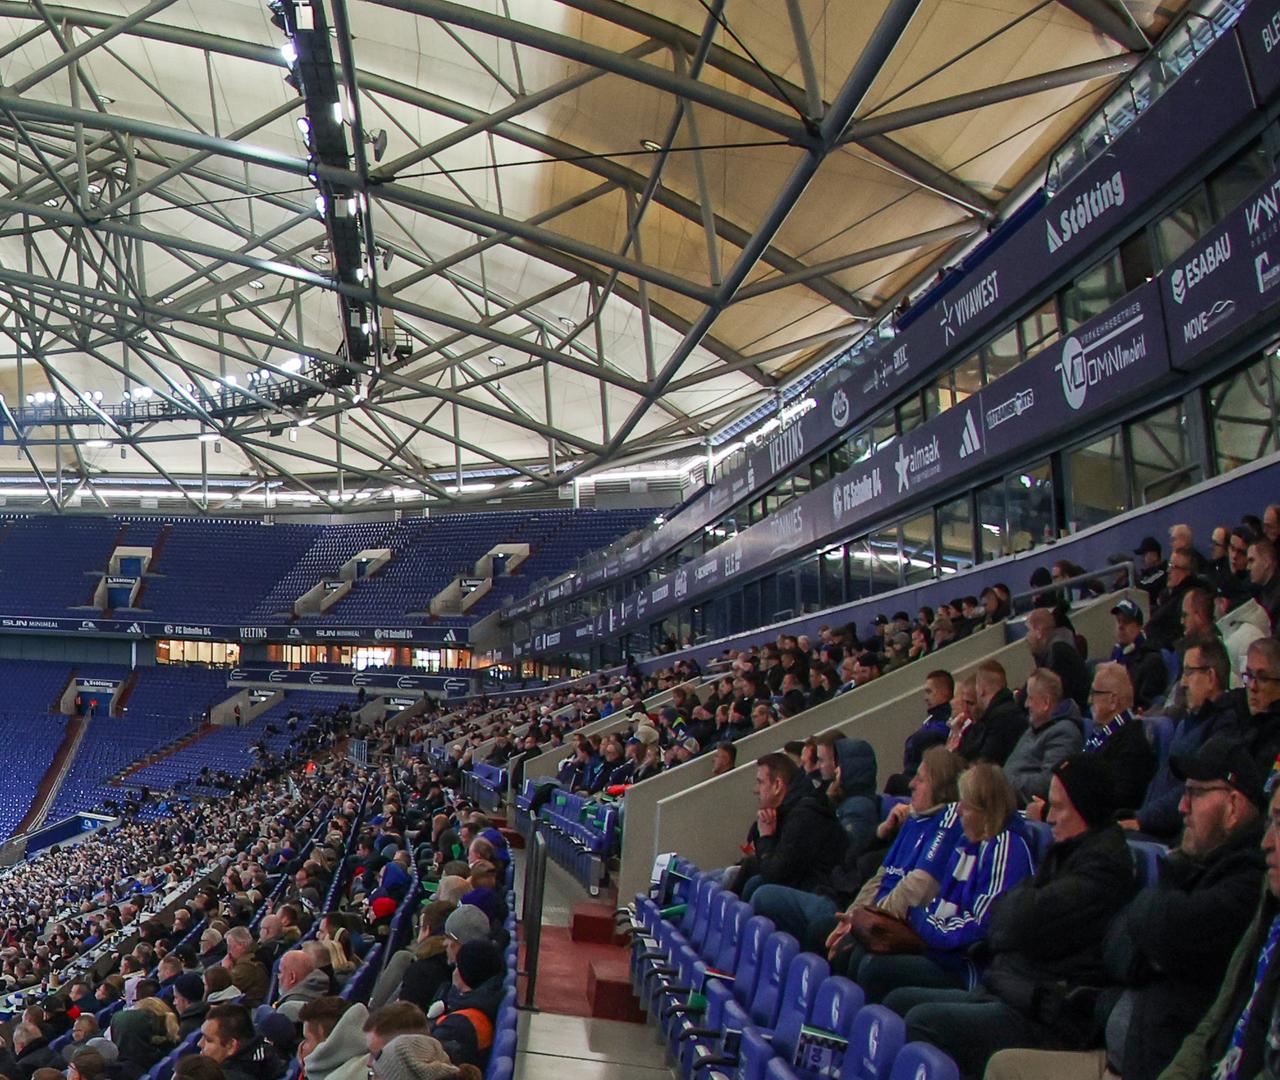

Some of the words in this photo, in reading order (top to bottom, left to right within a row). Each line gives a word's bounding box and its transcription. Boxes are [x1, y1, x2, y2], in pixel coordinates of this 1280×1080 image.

[1060, 171, 1127, 243] Stölting
[1185, 232, 1231, 289] ESABAU
[953, 270, 1000, 327] VIVAWEST
[1183, 311, 1209, 344] MOVE
[1087, 333, 1147, 386] OMNImobil
[769, 421, 804, 474] VELTINS
[909, 434, 940, 473] almaak
[240, 627, 268, 639] VELTINS
